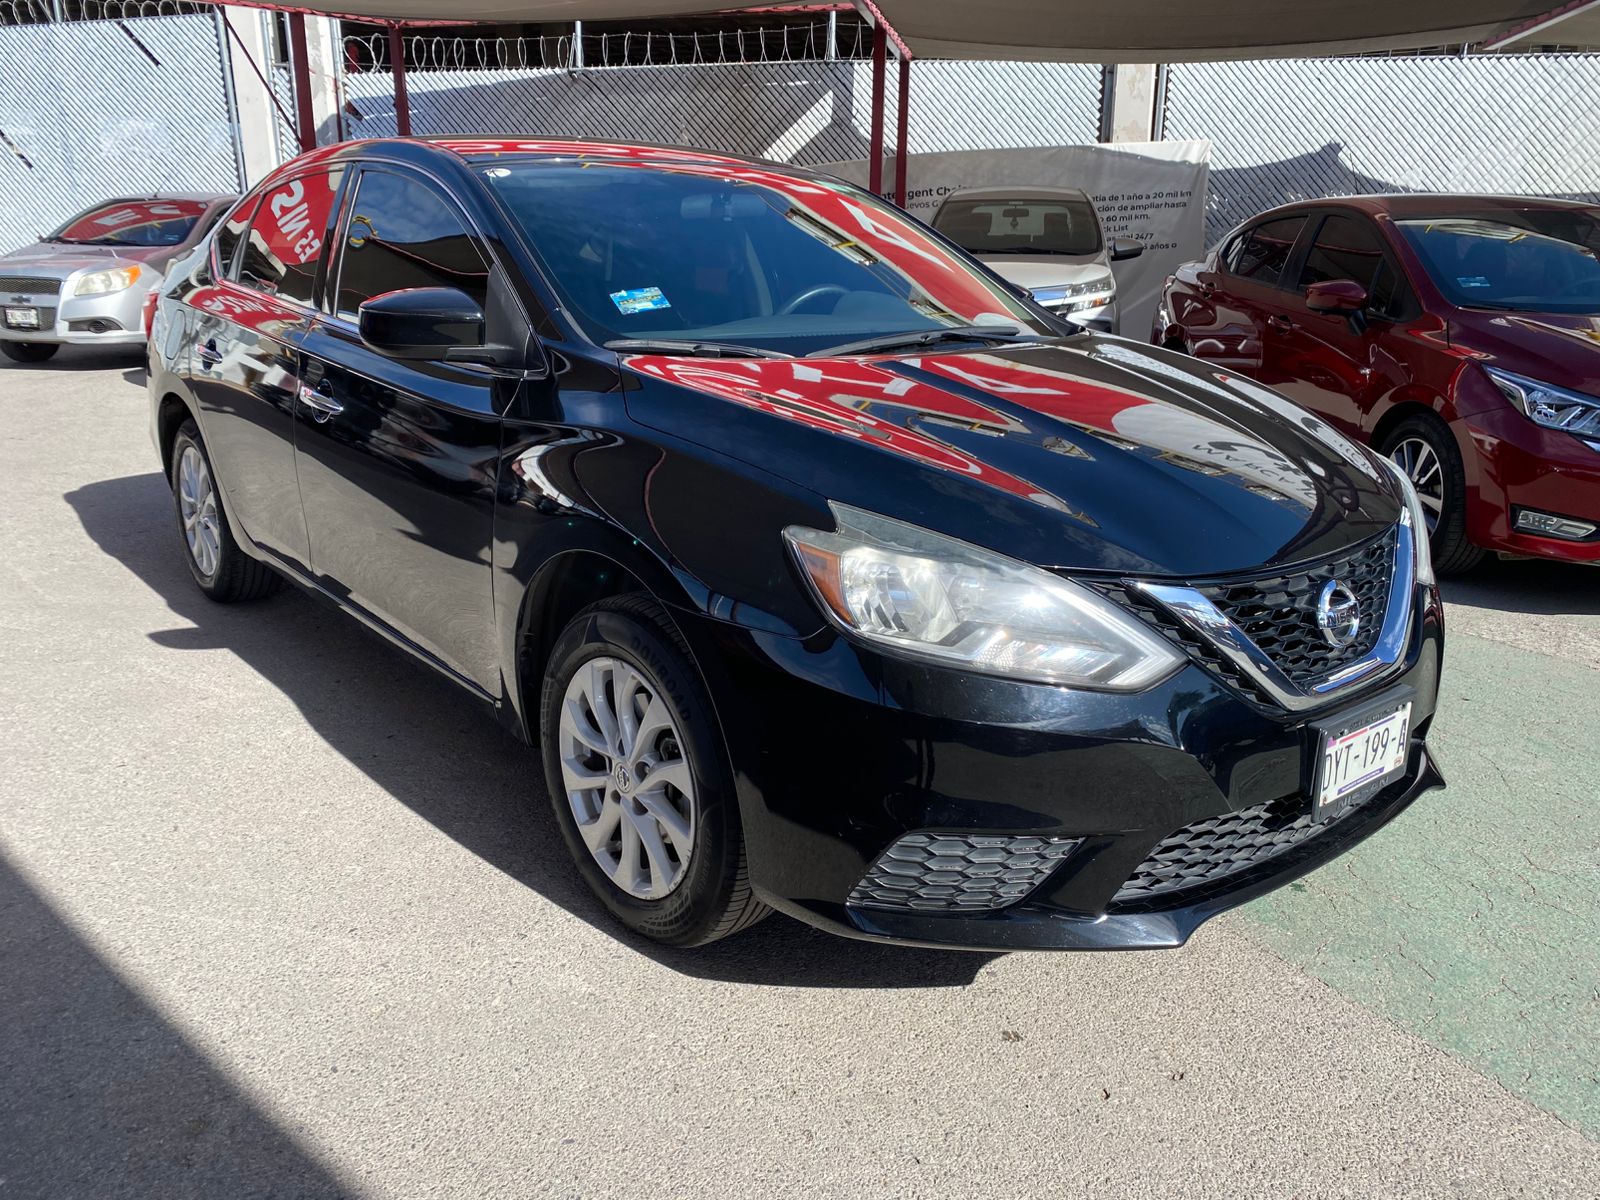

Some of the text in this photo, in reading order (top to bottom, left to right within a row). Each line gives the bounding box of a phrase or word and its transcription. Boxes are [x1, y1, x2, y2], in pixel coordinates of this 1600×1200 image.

[1108, 194, 1119, 202] de
[1126, 193, 1143, 201] año
[1152, 192, 1164, 200] 20
[1165, 191, 1178, 199] mil
[1117, 204, 1129, 212] de
[1130, 202, 1163, 213] ampliar
[1164, 201, 1187, 209] hasta
[1119, 214, 1133, 222] mil
[1134, 213, 1151, 221] km.
[1113, 224, 1128, 233] List
[1149, 242, 1170, 250] años
[1326, 605, 1359, 627] NISS
[1321, 718, 1407, 792] DYT-199-A
